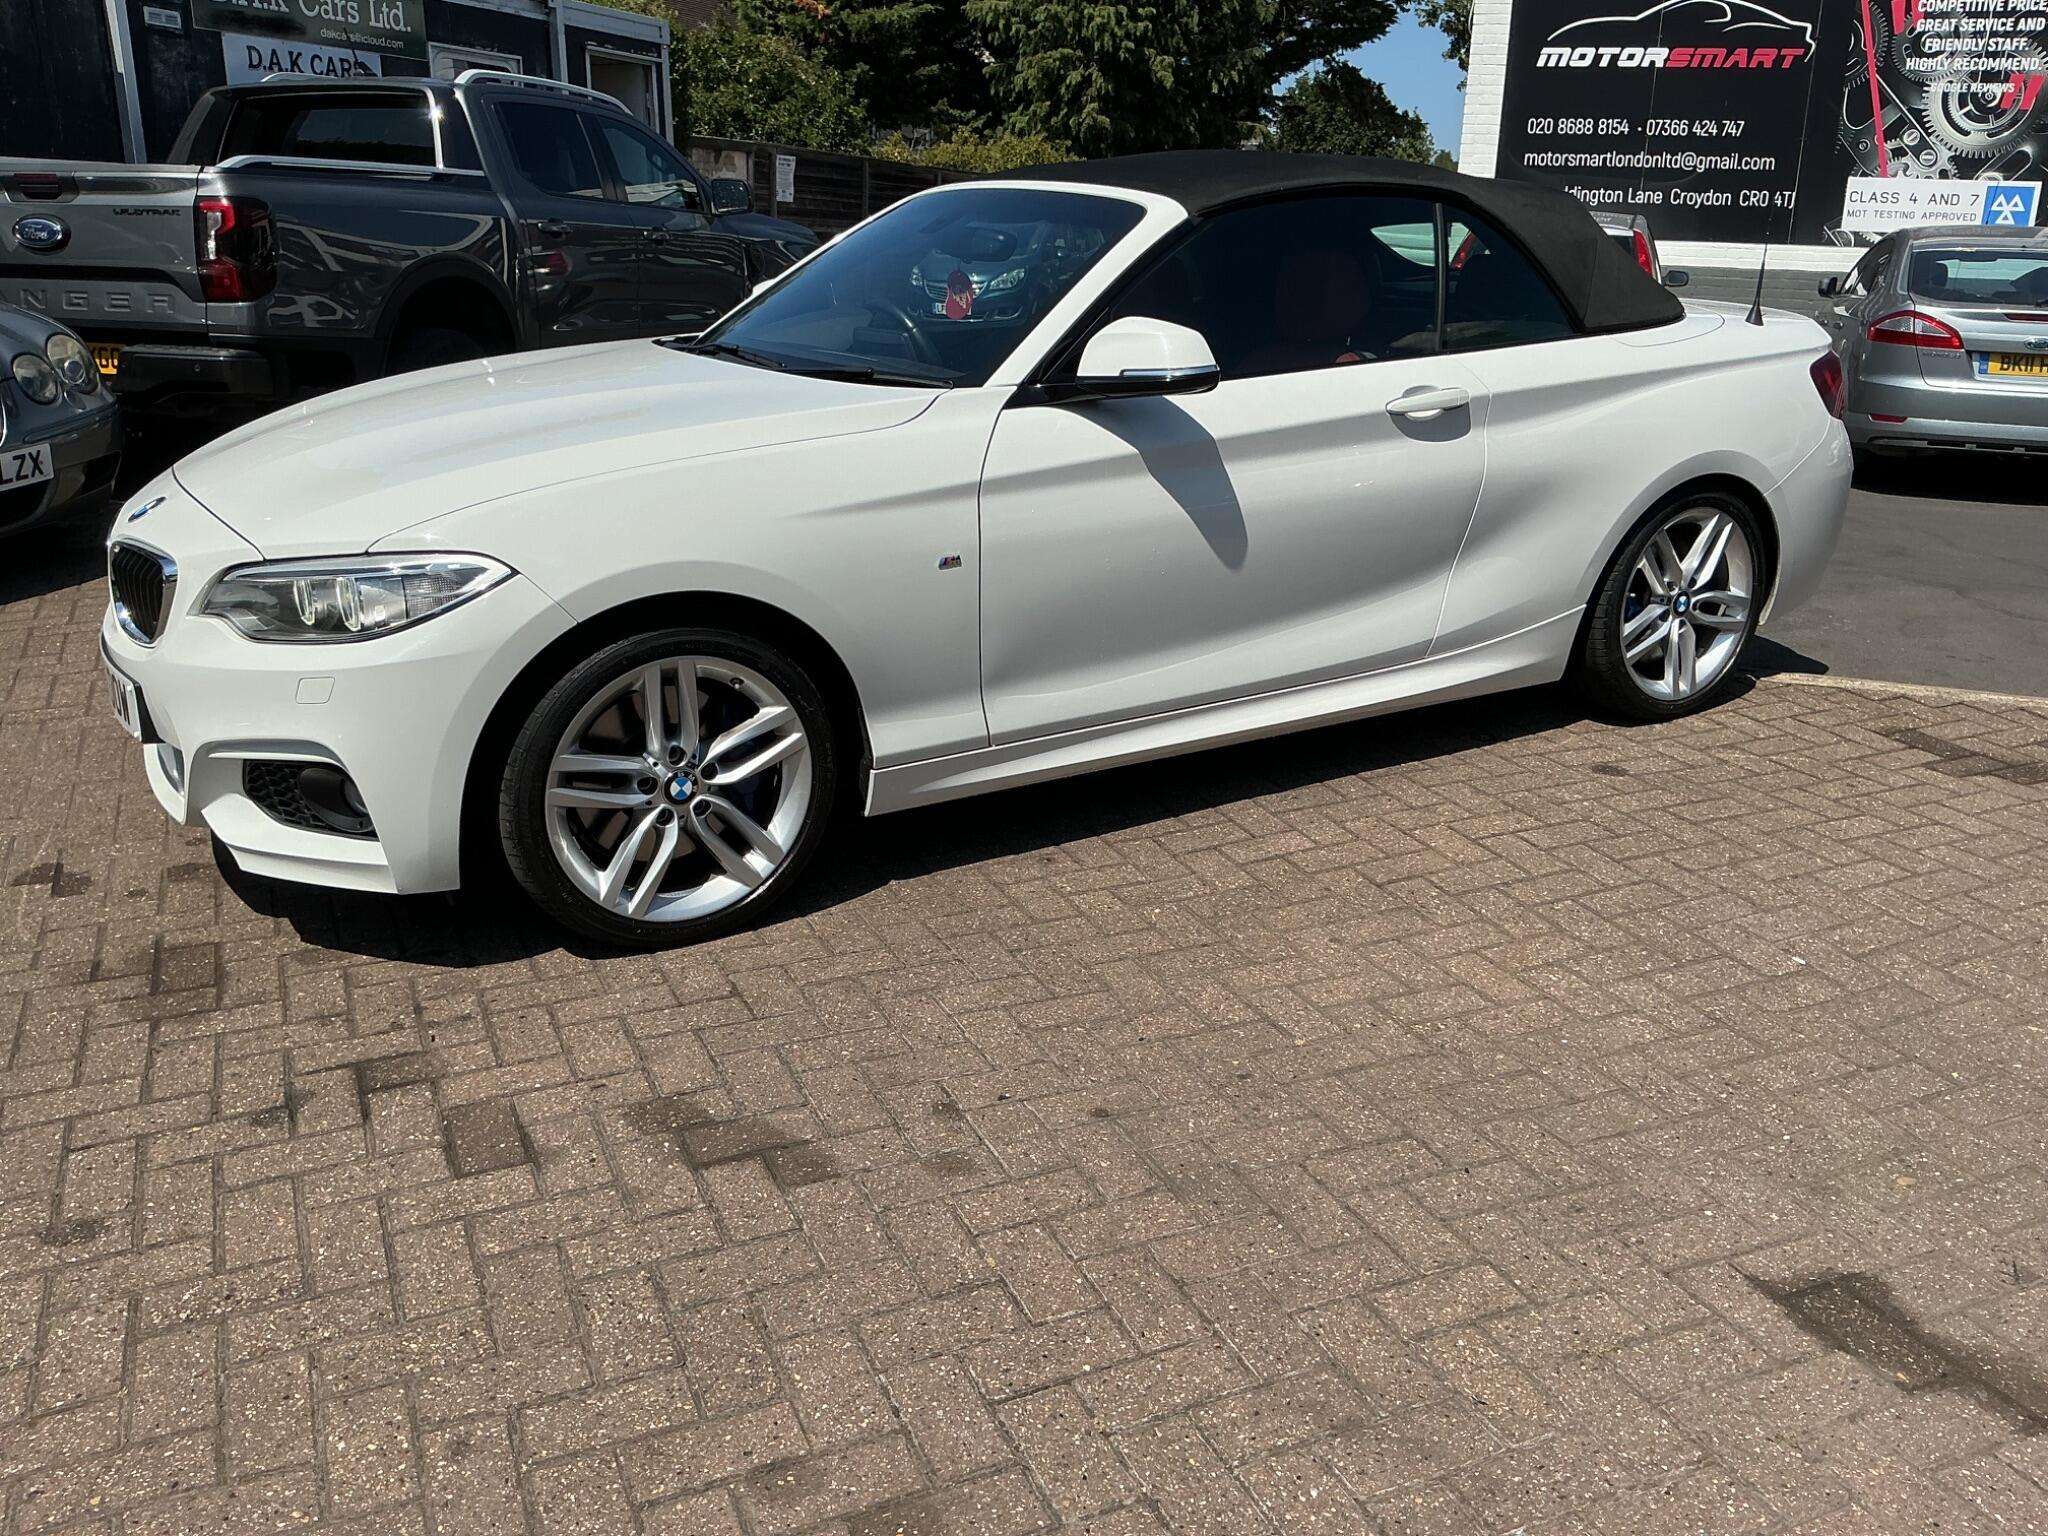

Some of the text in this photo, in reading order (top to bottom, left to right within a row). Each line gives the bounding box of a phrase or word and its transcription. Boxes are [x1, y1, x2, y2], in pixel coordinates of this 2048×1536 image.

[1918, 0, 2005, 12] COMPETITIVE
[300, 0, 360, 24] Cars
[369, 0, 411, 32] Ltd.
[1916, 17, 2046, 32] GREAT SERVICE AND
[1925, 38, 2029, 51] FRIENDLY STAFF.
[246, 45, 304, 73] D.A.K
[1536, 47, 1805, 68] MOTORSMART
[1906, 57, 2042, 71] HIGHLY RECOMMEND.
[1971, 82, 2015, 93] REVIEWS
[1527, 118, 1745, 137] 020 8688 8154 07366 424 747
[1524, 151, 1775, 173] motorsmartlondonltd@gmail.com
[1628, 188, 1663, 205] Lane
[1670, 188, 1731, 209] Croydon
[1775, 191, 1796, 209] 4TJ
[1849, 191, 1980, 206] CLASS 4 AND 7
[1847, 209, 1977, 222] MOT TESTING APPROVED
[10, 289, 174, 314] NGER
